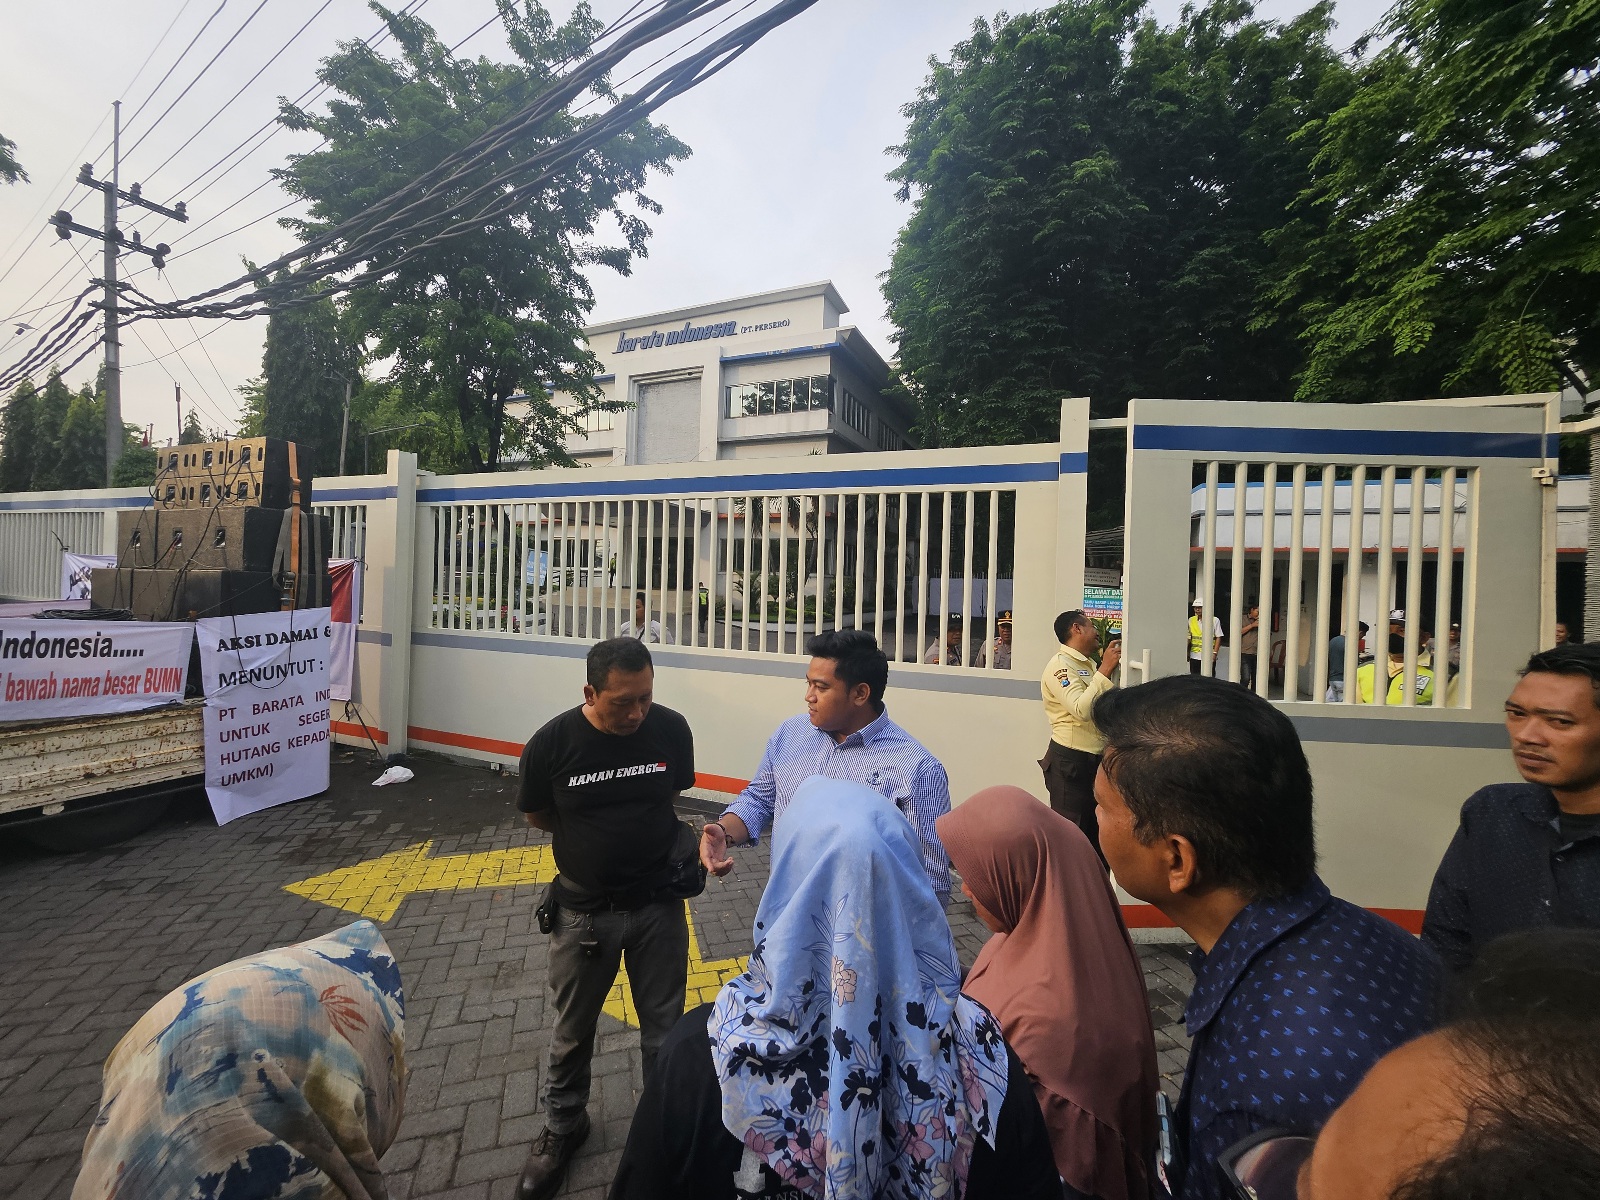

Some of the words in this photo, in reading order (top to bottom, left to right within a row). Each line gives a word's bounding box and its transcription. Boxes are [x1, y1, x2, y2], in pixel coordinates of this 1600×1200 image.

[754, 318, 791, 332] PERSERO)
[216, 634, 262, 652] AKSI
[265, 627, 318, 646] DAMAI
[5, 671, 58, 702] bawah
[60, 676, 101, 699] nama
[102, 670, 142, 696] besar
[143, 667, 183, 693] BUMN
[218, 658, 316, 688] MENUNTUT
[219, 707, 237, 721] PT
[252, 695, 305, 716] BARATA
[219, 722, 271, 743] UNTUK
[220, 741, 281, 766] HUTANG
[220, 763, 274, 787] UMKM)
[568, 769, 615, 786] HAMAN
[615, 762, 659, 778] ENERGY
